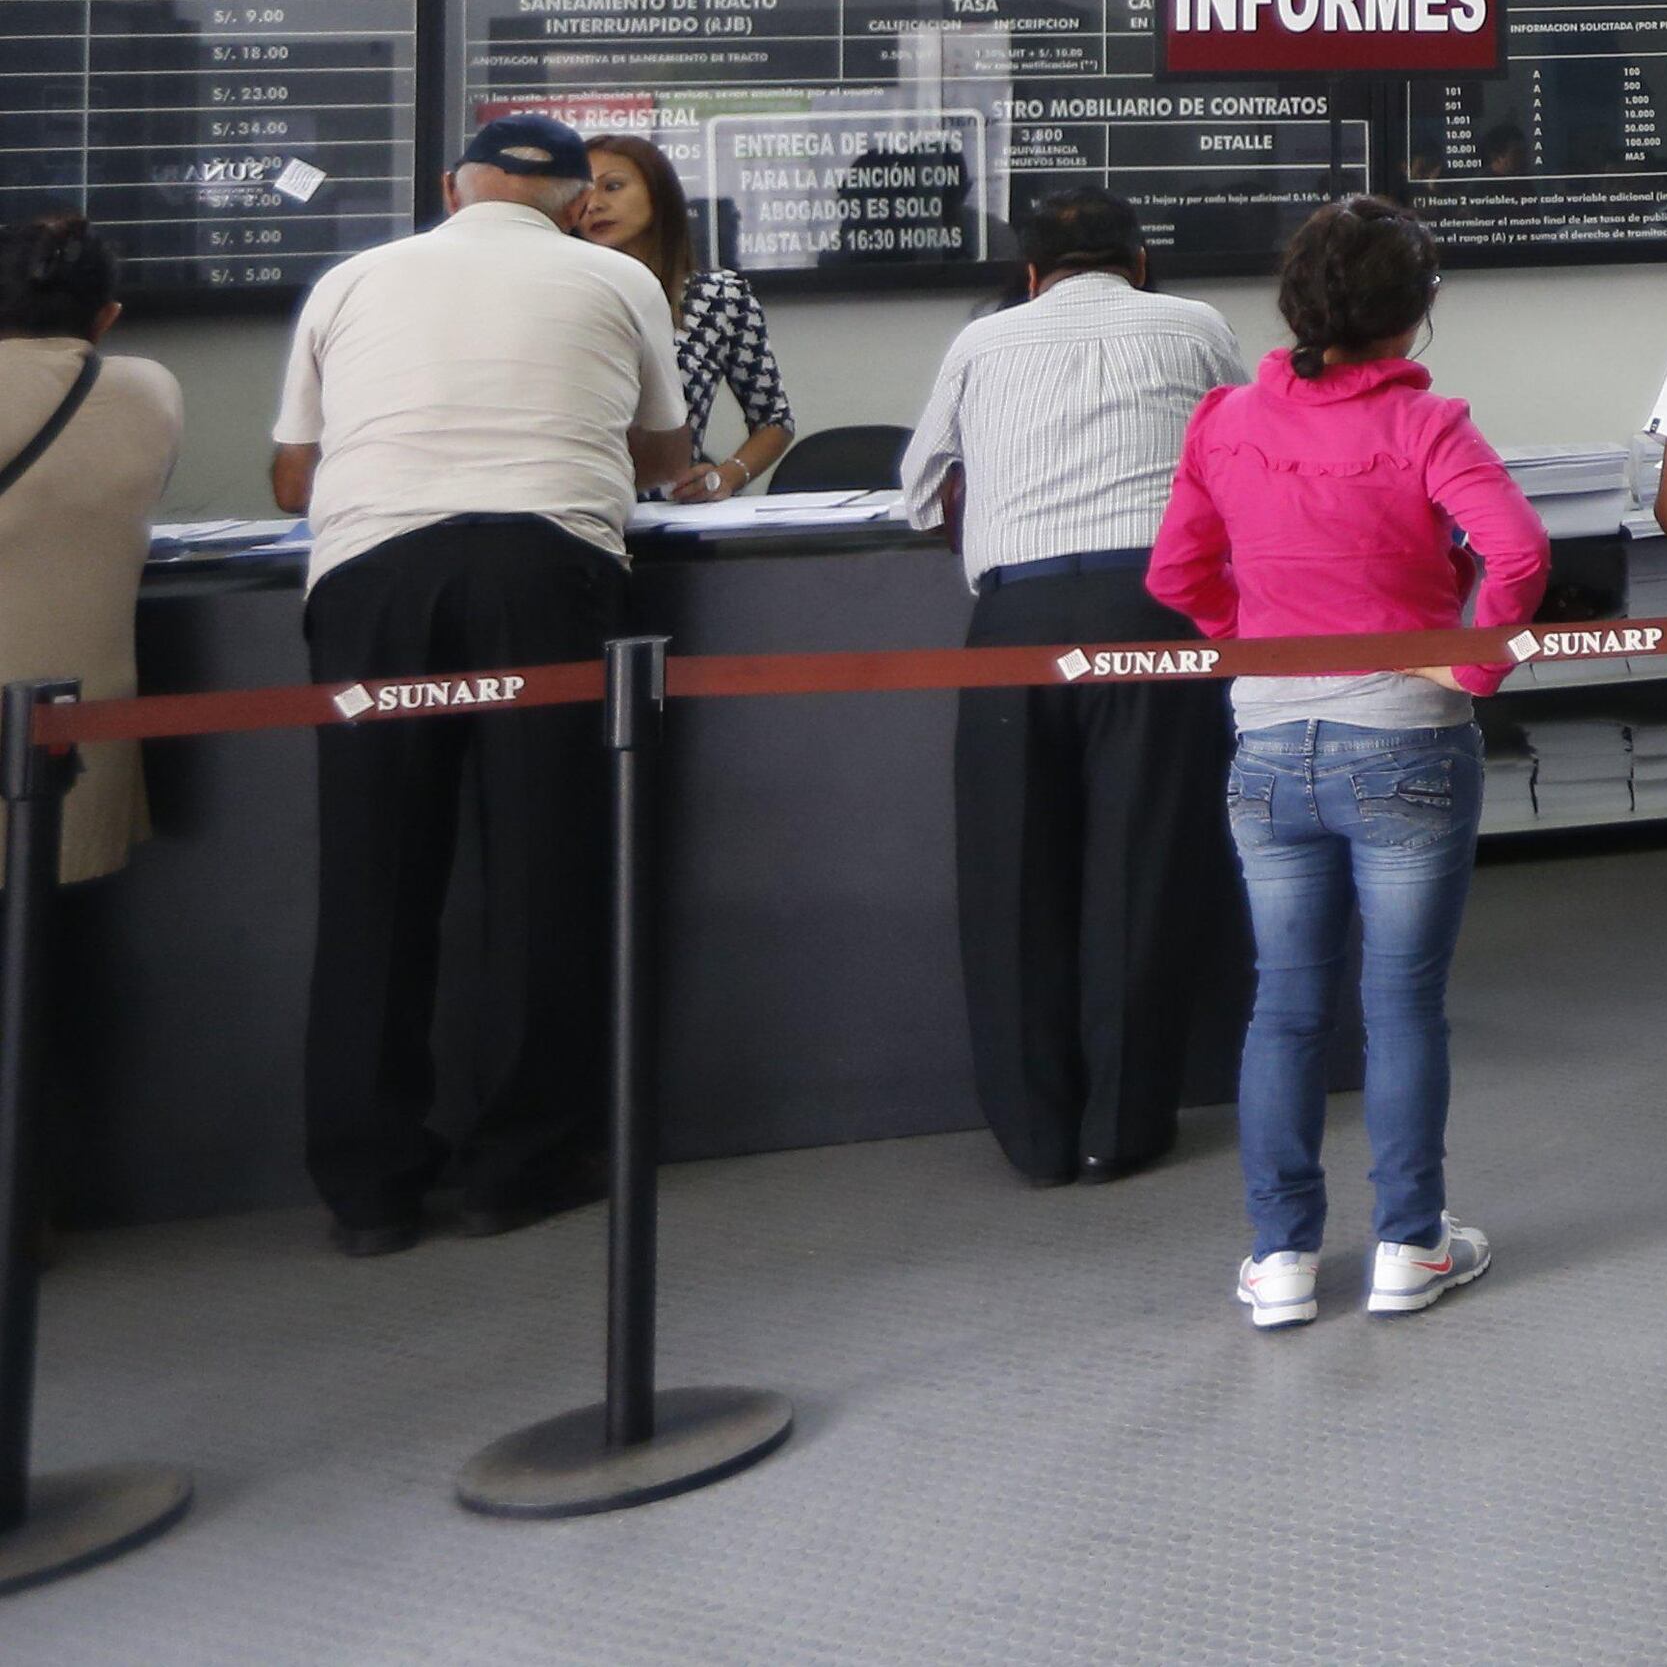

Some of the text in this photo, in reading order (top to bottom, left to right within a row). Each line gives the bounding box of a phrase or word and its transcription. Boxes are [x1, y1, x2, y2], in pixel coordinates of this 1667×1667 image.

[1050, 98, 1171, 116] MOBILIARIO
[1179, 98, 1203, 114] DE
[1211, 97, 1326, 115] CONTRATOS
[734, 128, 962, 156] ENTREGA DE TICKETS
[741, 165, 958, 190] PARA LA ATENCIÓN CON
[760, 197, 941, 220] ABOGADOS ES SOLO
[741, 225, 961, 253] HASTA LAS 16:30 HORAS
[1543, 628, 1661, 655] SUNARP
[1094, 649, 1218, 675] SUNARP
[378, 676, 523, 710] SUNARP
